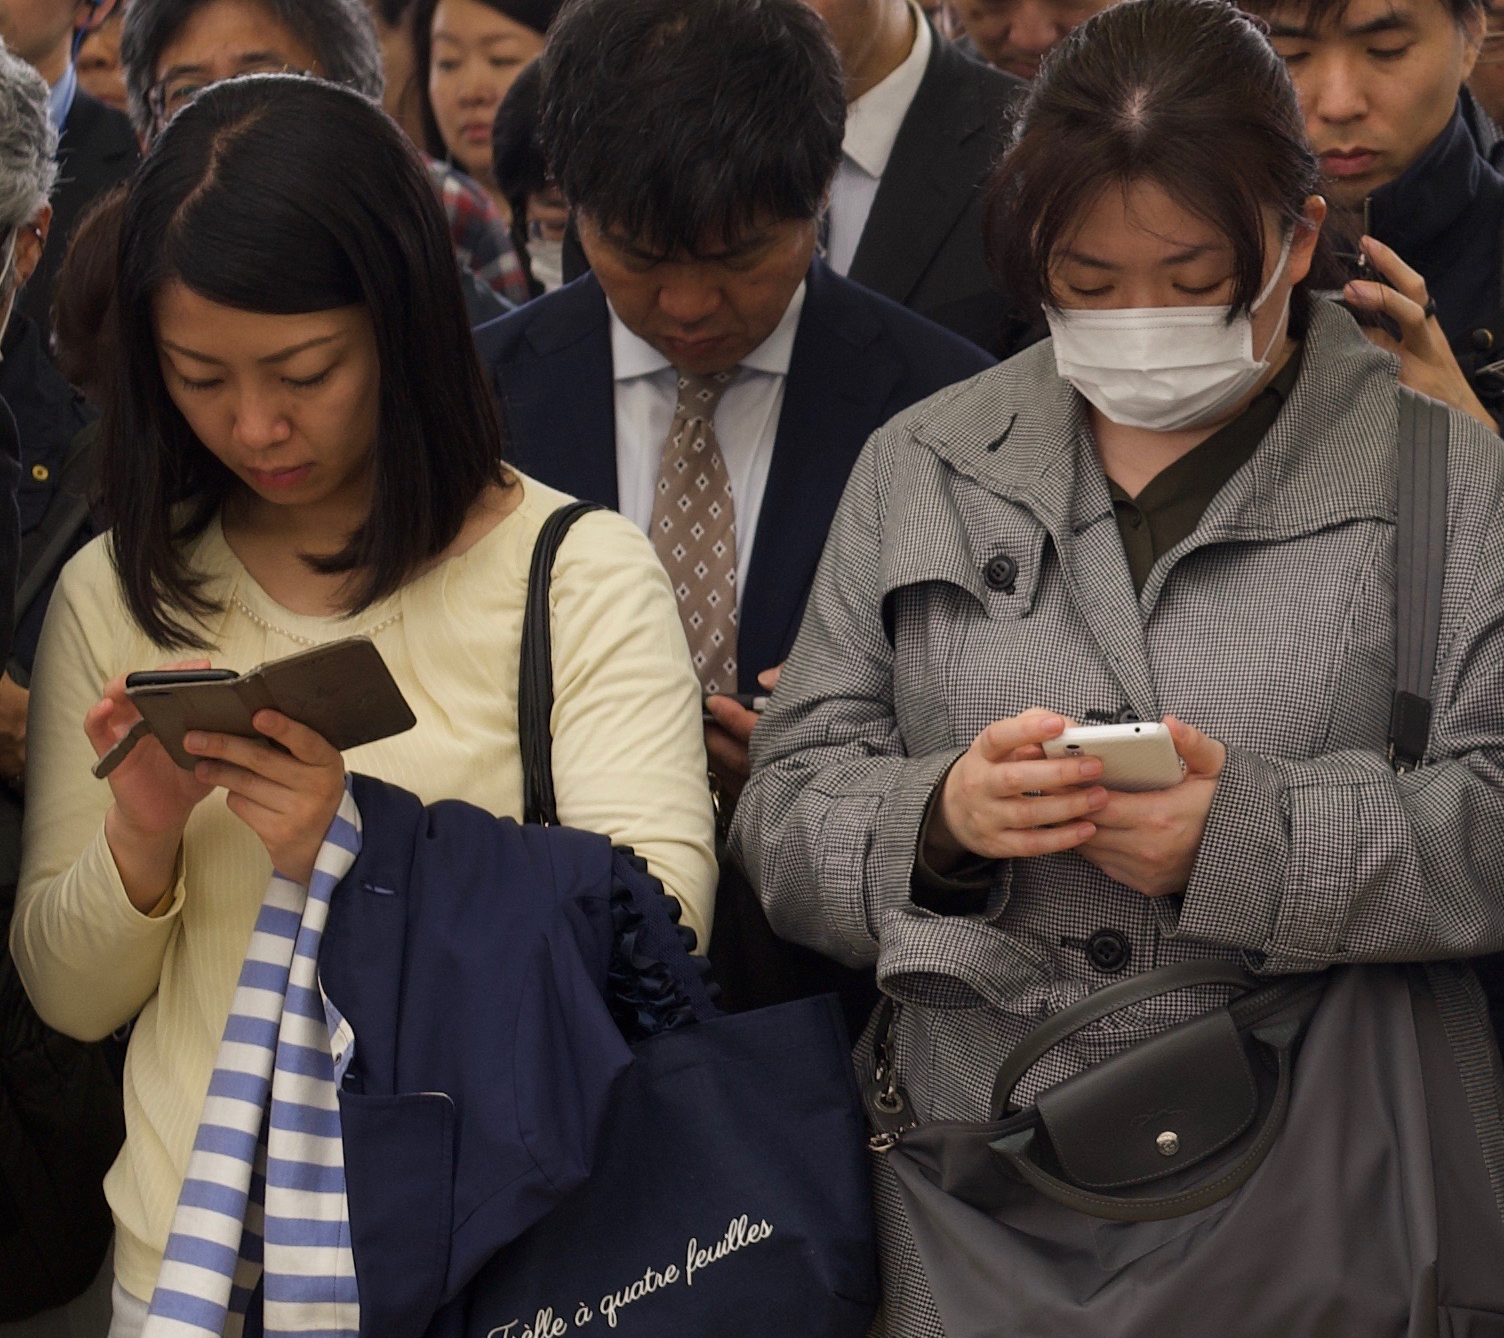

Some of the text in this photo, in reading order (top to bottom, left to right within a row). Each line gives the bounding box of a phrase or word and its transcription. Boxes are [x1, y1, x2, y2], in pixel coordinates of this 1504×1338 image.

[574, 1301, 593, 1327] à
[599, 1262, 680, 1328] quatre
[685, 1213, 774, 1286] feuilles
